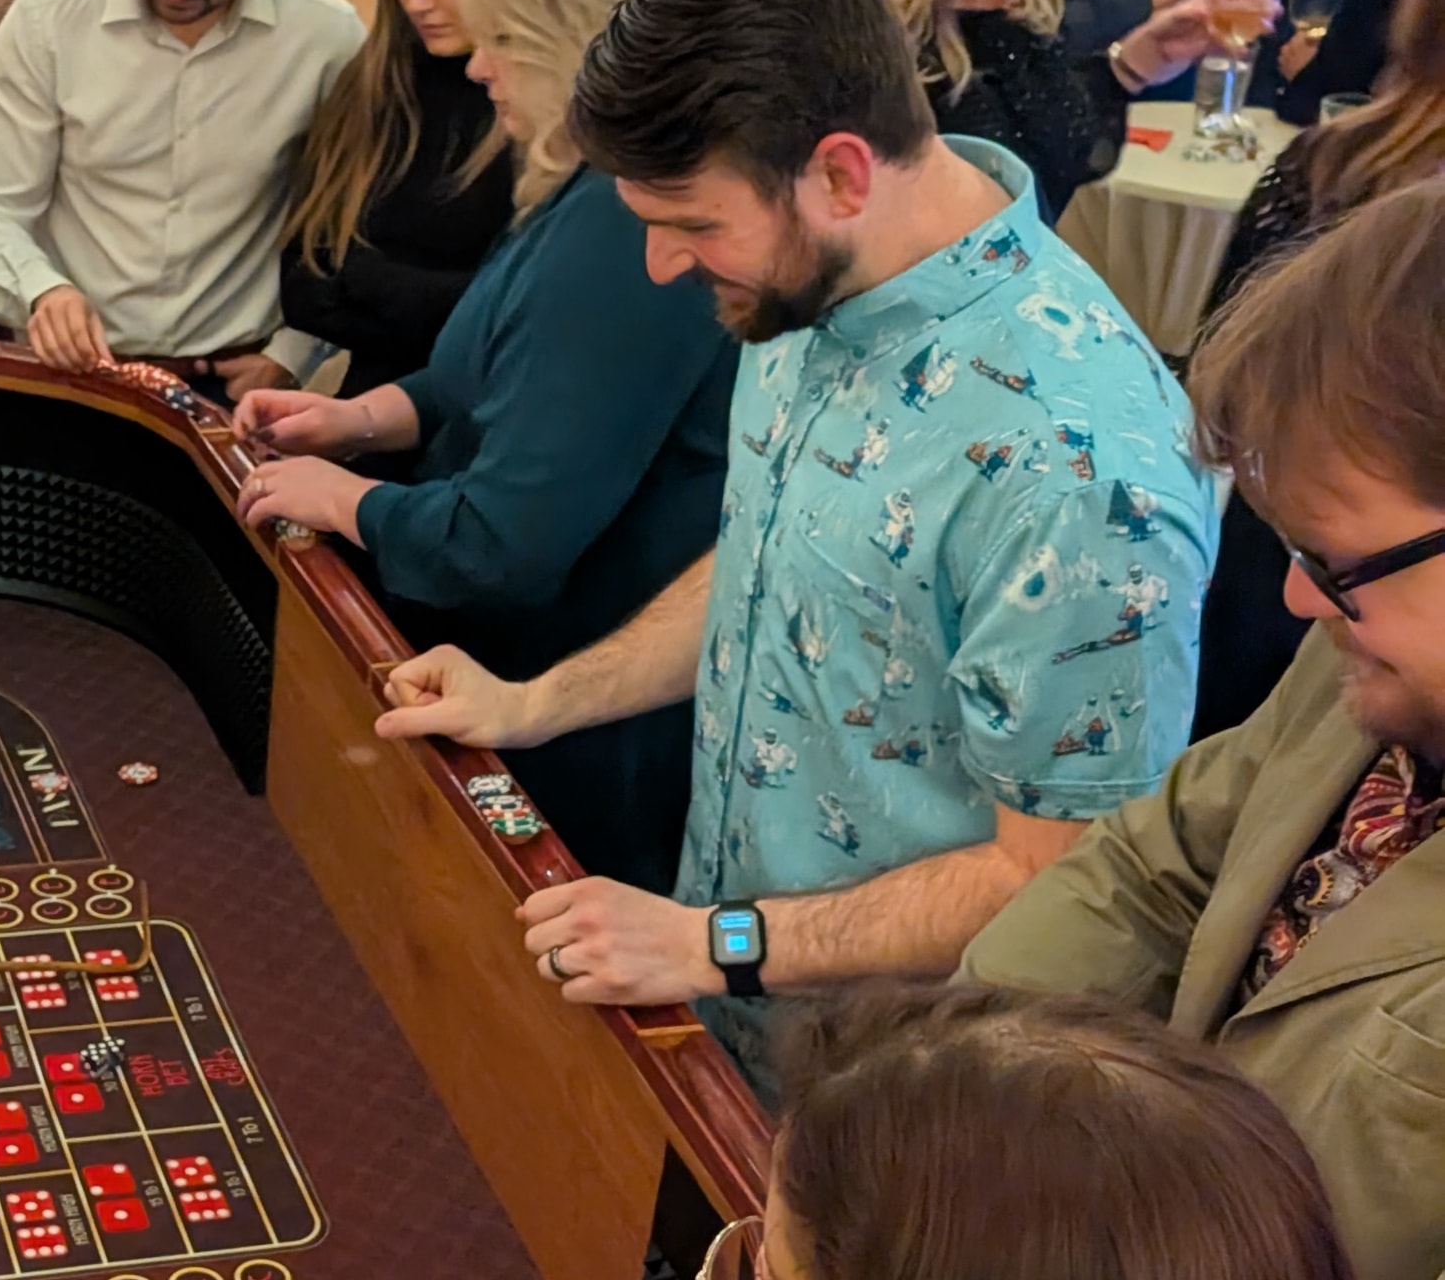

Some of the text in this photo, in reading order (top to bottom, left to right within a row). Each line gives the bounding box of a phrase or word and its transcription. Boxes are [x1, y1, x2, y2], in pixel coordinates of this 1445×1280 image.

[128, 1054, 164, 1097] HORN
[157, 1059, 190, 1086] BET
[214, 1047, 245, 1086] CRAPS
